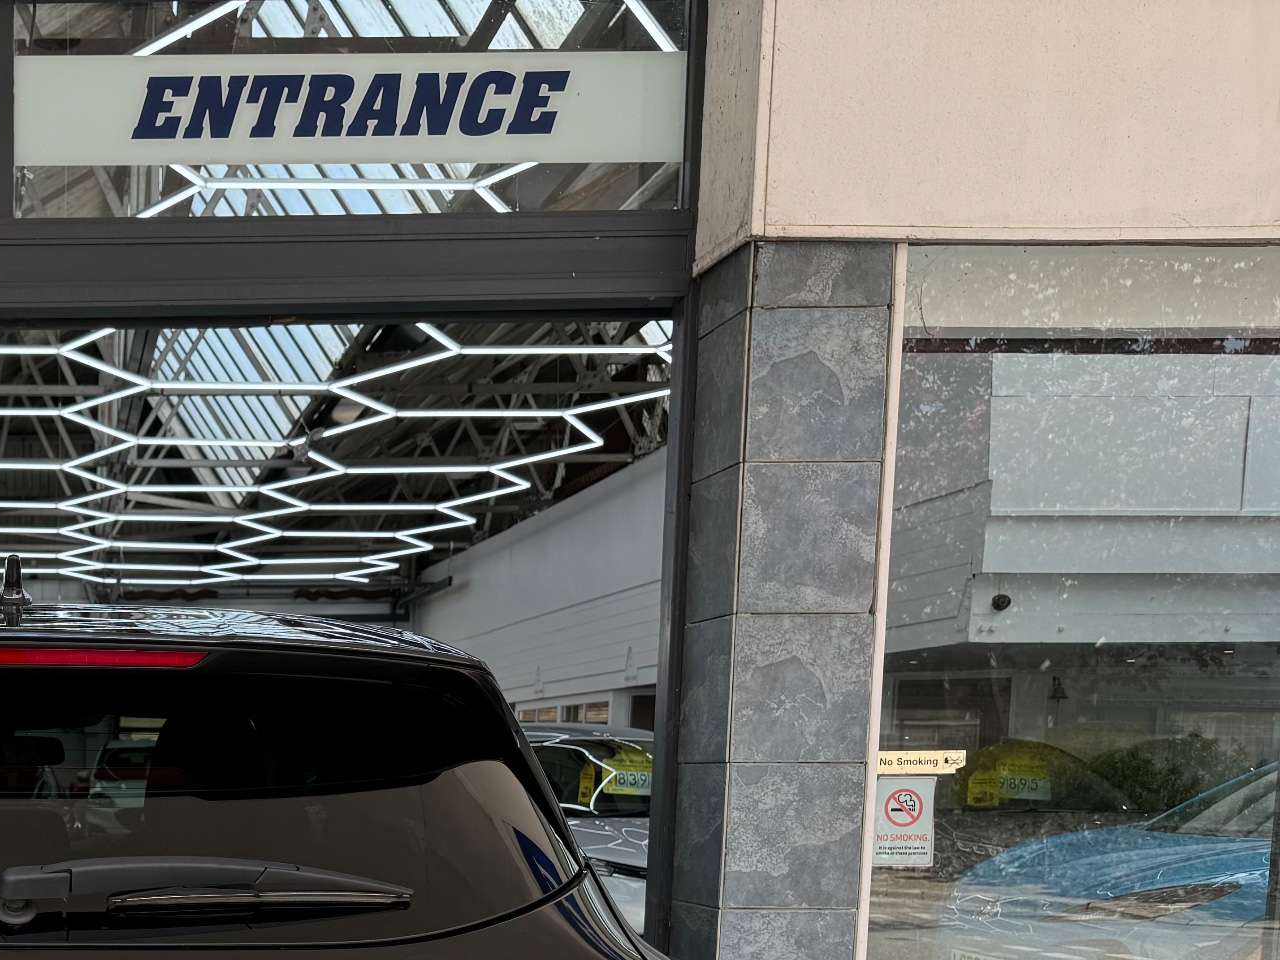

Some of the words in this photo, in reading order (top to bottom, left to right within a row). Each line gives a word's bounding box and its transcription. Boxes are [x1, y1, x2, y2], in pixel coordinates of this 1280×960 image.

[130, 70, 571, 140] ENTRANCE
[879, 757, 893, 766] No
[896, 757, 939, 768] Smoking
[876, 833, 890, 842] NO
